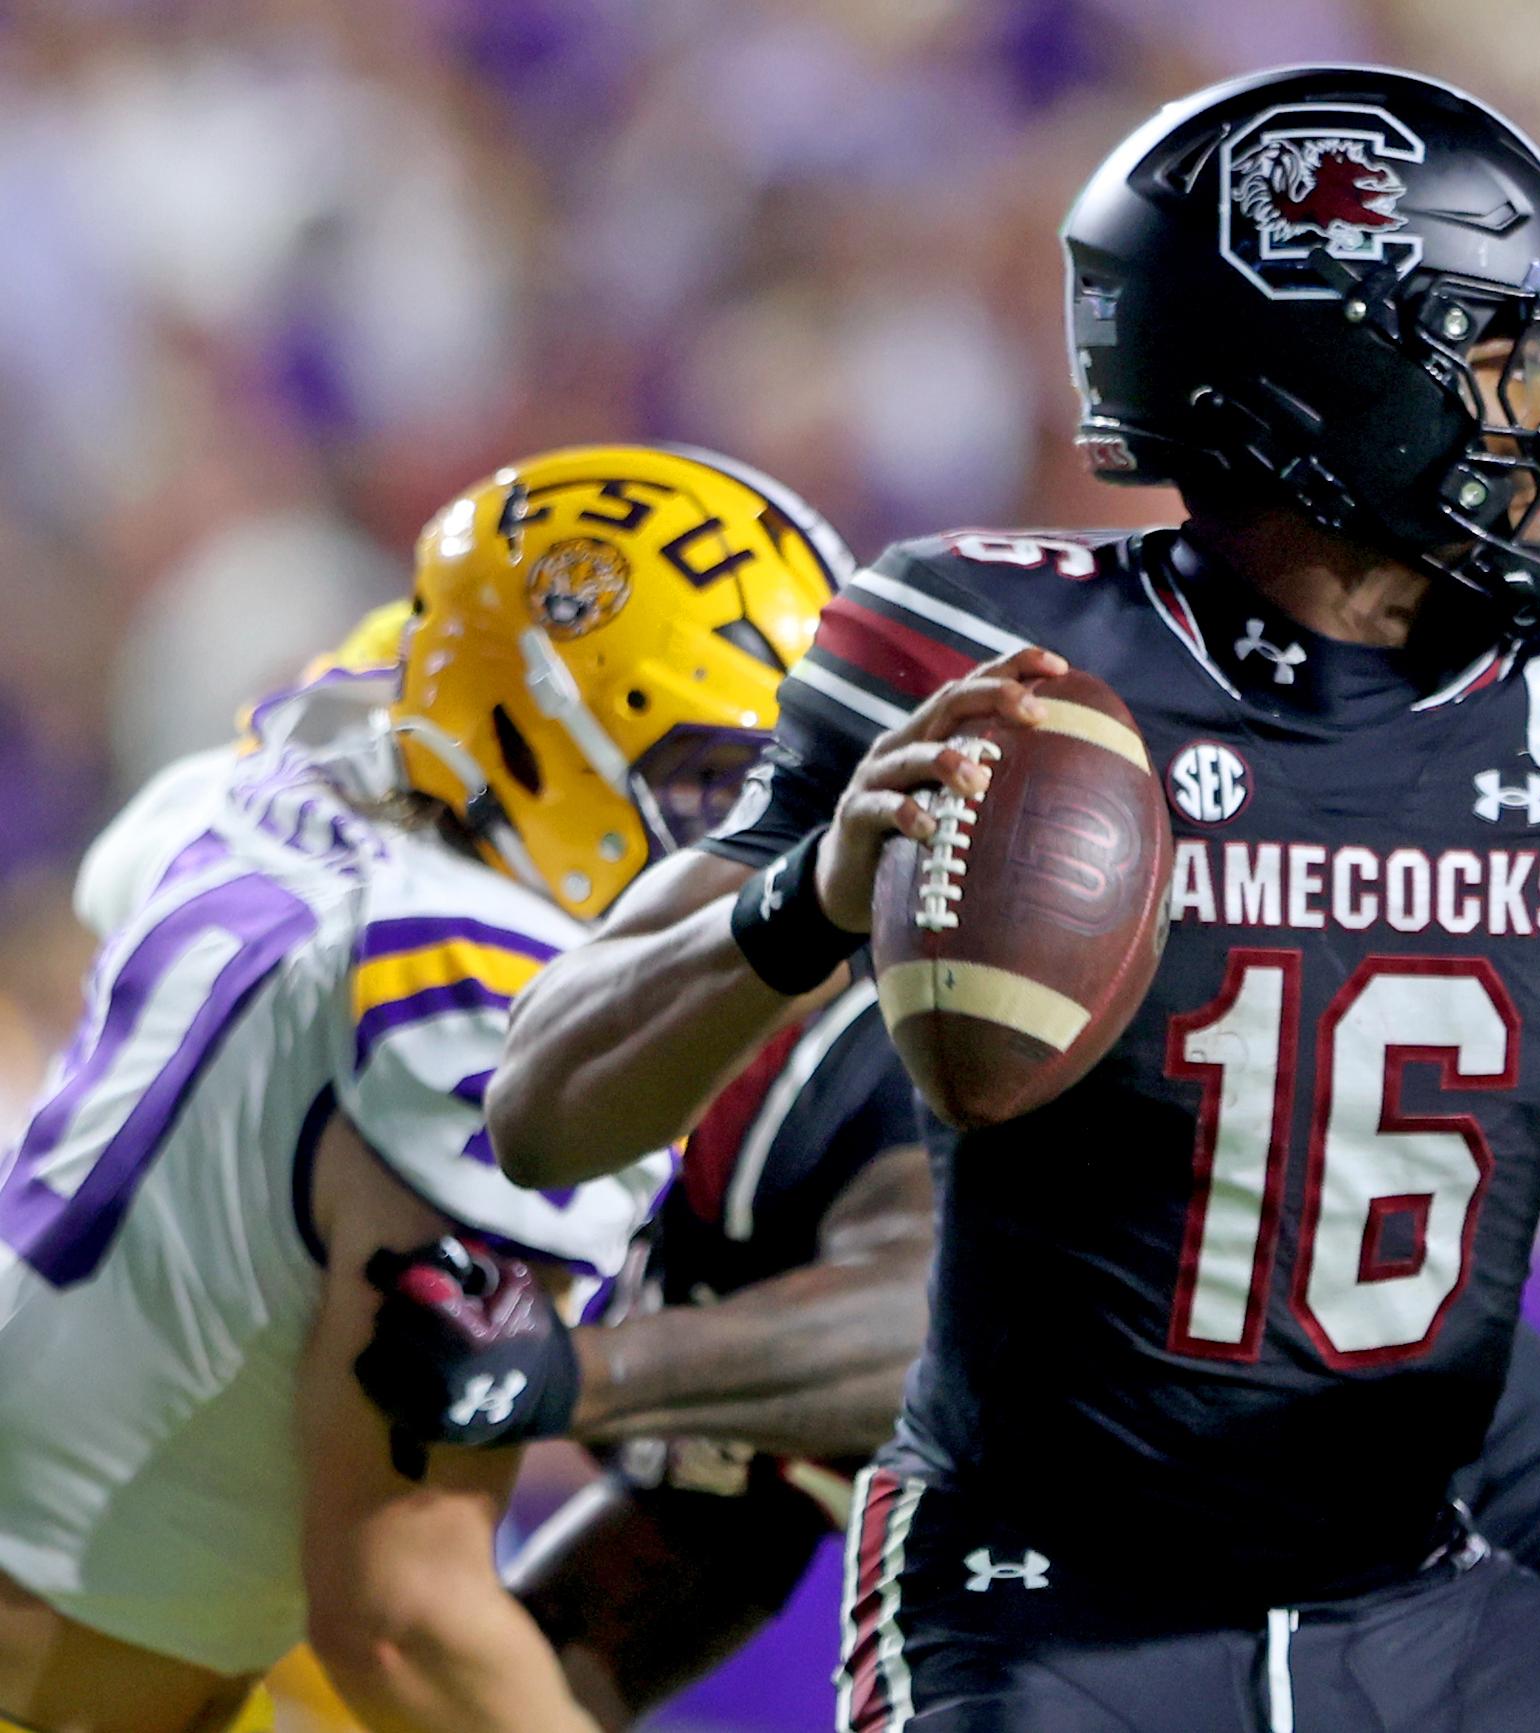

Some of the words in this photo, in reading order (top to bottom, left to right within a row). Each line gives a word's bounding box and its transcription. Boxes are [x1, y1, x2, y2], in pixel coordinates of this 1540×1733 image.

[498, 478, 756, 588] LSU
[1171, 743, 1249, 823] SEC
[1163, 948, 1524, 1371] 16
